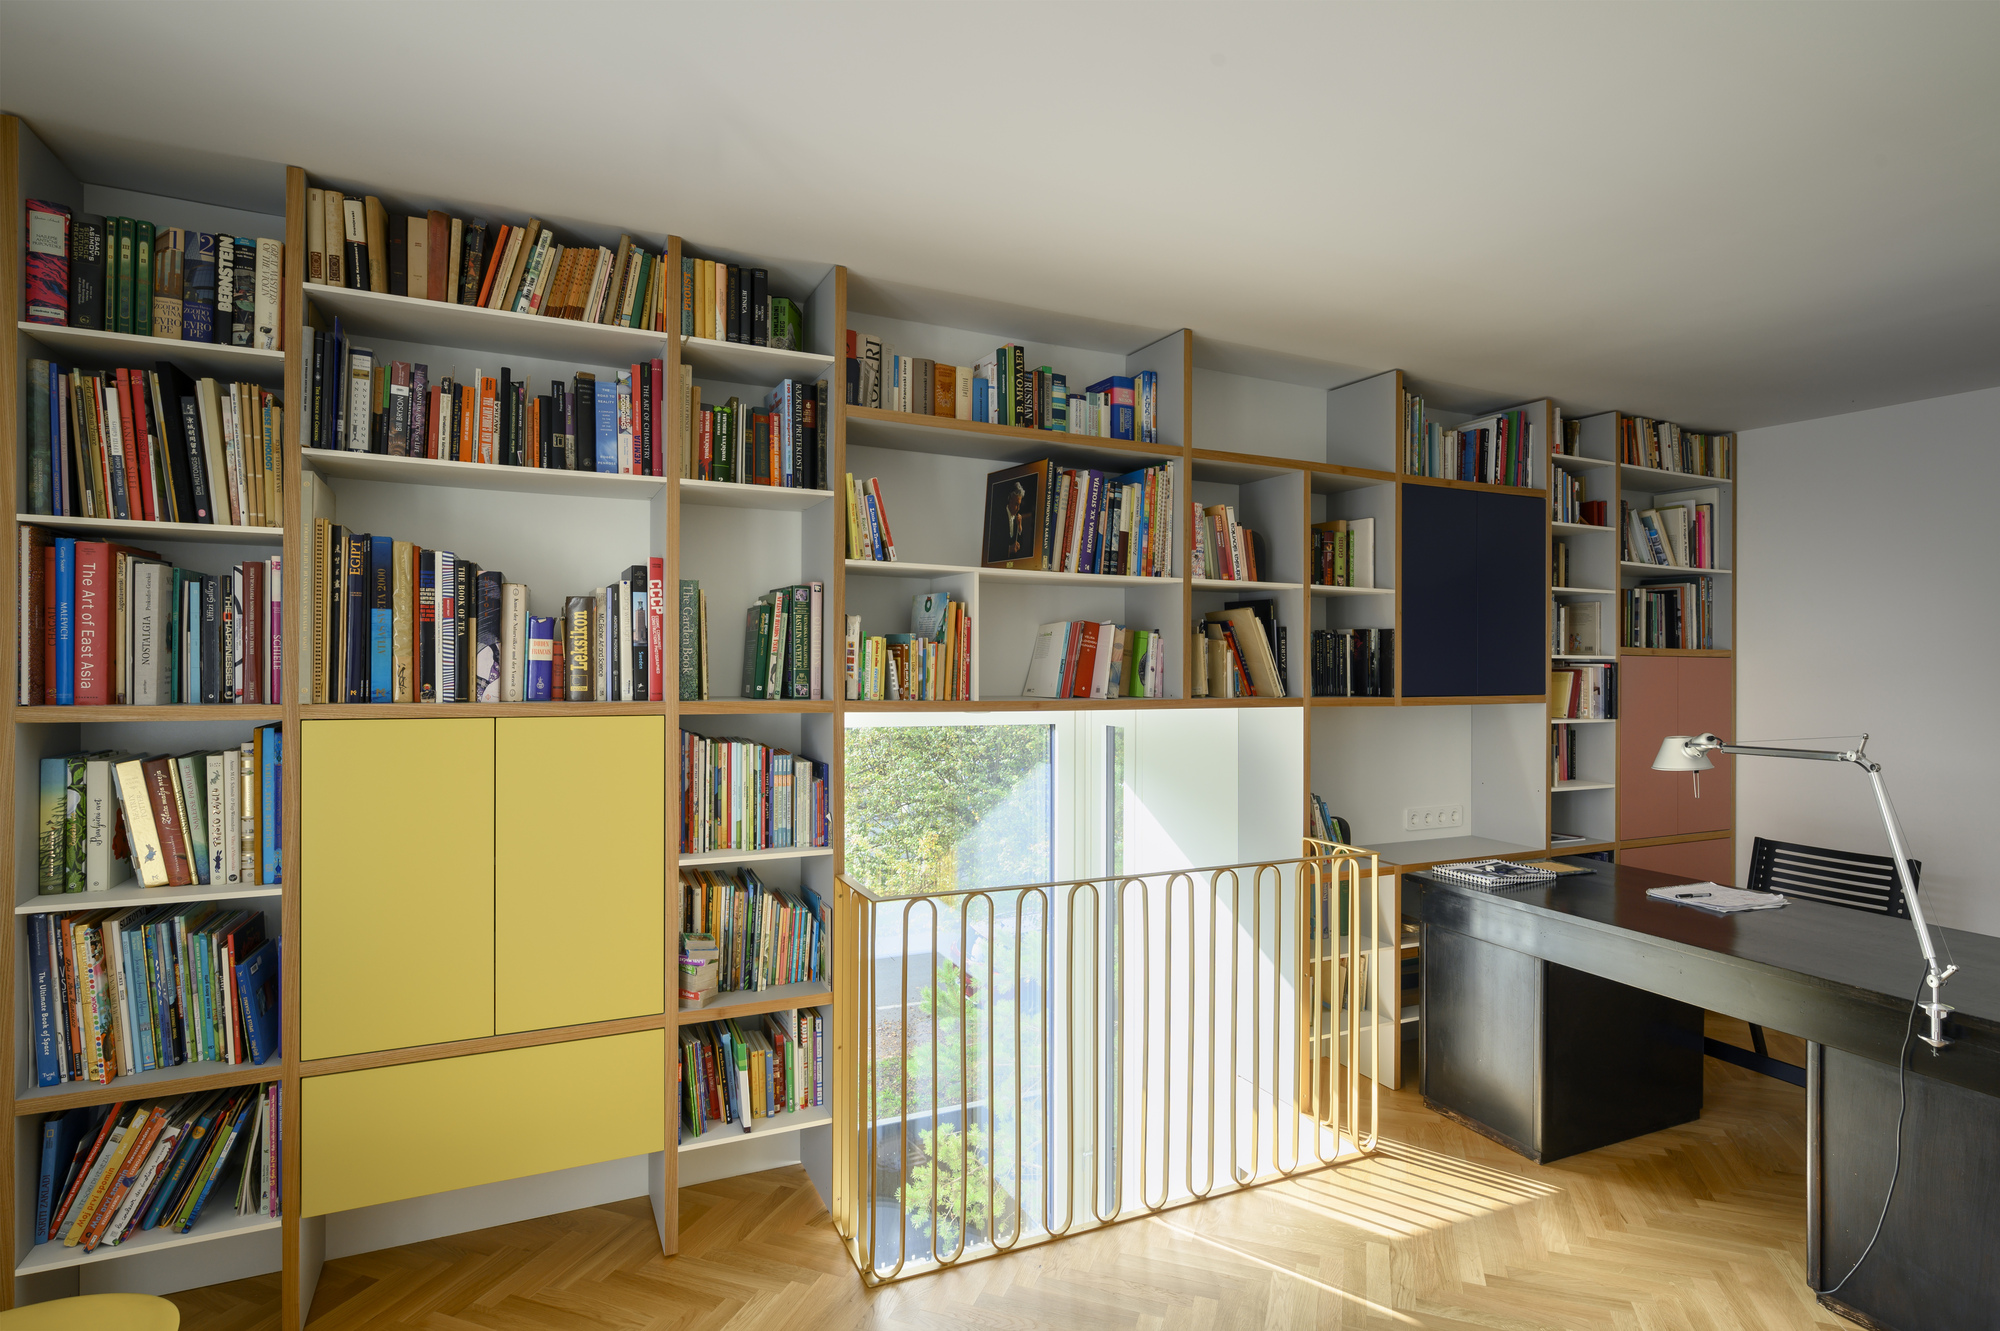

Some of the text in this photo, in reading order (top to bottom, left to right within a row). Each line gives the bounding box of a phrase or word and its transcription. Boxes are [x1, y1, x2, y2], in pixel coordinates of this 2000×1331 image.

[201, 235, 214, 255] 2
[261, 251, 270, 269] THE
[217, 235, 235, 313] BERNSTEIN
[261, 269, 270, 298] VIOLIN
[270, 243, 279, 305] GREAT MASTERS
[154, 304, 180, 313] ZGODO
[683, 272, 691, 311] PROUST
[154, 317, 182, 328] EVRO
[160, 325, 174, 334] PE
[162, 310, 182, 318] VINA
[183, 308, 210, 317] ZGODO
[183, 320, 212, 332] EVRO
[192, 314, 212, 323] VINA
[190, 329, 204, 339] PE
[85, 379, 94, 393] Art
[1016, 349, 1024, 413] В. МЮЛЛЕР
[87, 393, 95, 420] Treasures
[396, 395, 404, 421] BRYSON
[643, 413, 650, 422] OF
[1024, 381, 1033, 420] RUSSIAN
[482, 396, 493, 443] THE EMPEROR'S NEW
[122, 416, 137, 490] JEANLOUP SIEFF
[264, 427, 273, 471] MYTHOLOGY
[190, 456, 200, 485] HUTONGS
[1086, 521, 1095, 553] KRONIKA
[1091, 477, 1100, 508] STOLETJA
[1230, 523, 1238, 552] slovnica
[349, 540, 361, 575] EGIPT
[205, 581, 217, 622] Uffizi Gallery
[377, 568, 386, 654] ATLAS SVETA 2000
[458, 608, 465, 619] OF
[649, 579, 663, 614] CCCP
[60, 601, 68, 640] MALEVICH
[80, 563, 96, 689] The Art of East Asia
[682, 584, 693, 674] The Garden Book
[142, 616, 151, 665] NOSTALGIA
[225, 594, 233, 685] THE HAPPINESSES
[273, 634, 281, 670] SCHIELE
[570, 610, 588, 671] Leksikon
[154, 770, 172, 825] Zlata mačja preja
[184, 765, 196, 799] PRAVLJICE
[38, 971, 46, 984] The
[39, 984, 47, 1012] Ultimate
[69, 998, 77, 1028] Francisco
[41, 1012, 50, 1030] Book
[42, 1038, 50, 1056] Space
[78, 1186, 93, 1206] TESORI
[93, 1154, 110, 1178] VENEZIA
[172, 1159, 187, 1181] ZAKAJ?
[37, 1174, 50, 1236] SKRITI ZAKLADI
[76, 1212, 92, 1228] Moj
[85, 1195, 100, 1211] prvi
[95, 1167, 115, 1194] spomin
